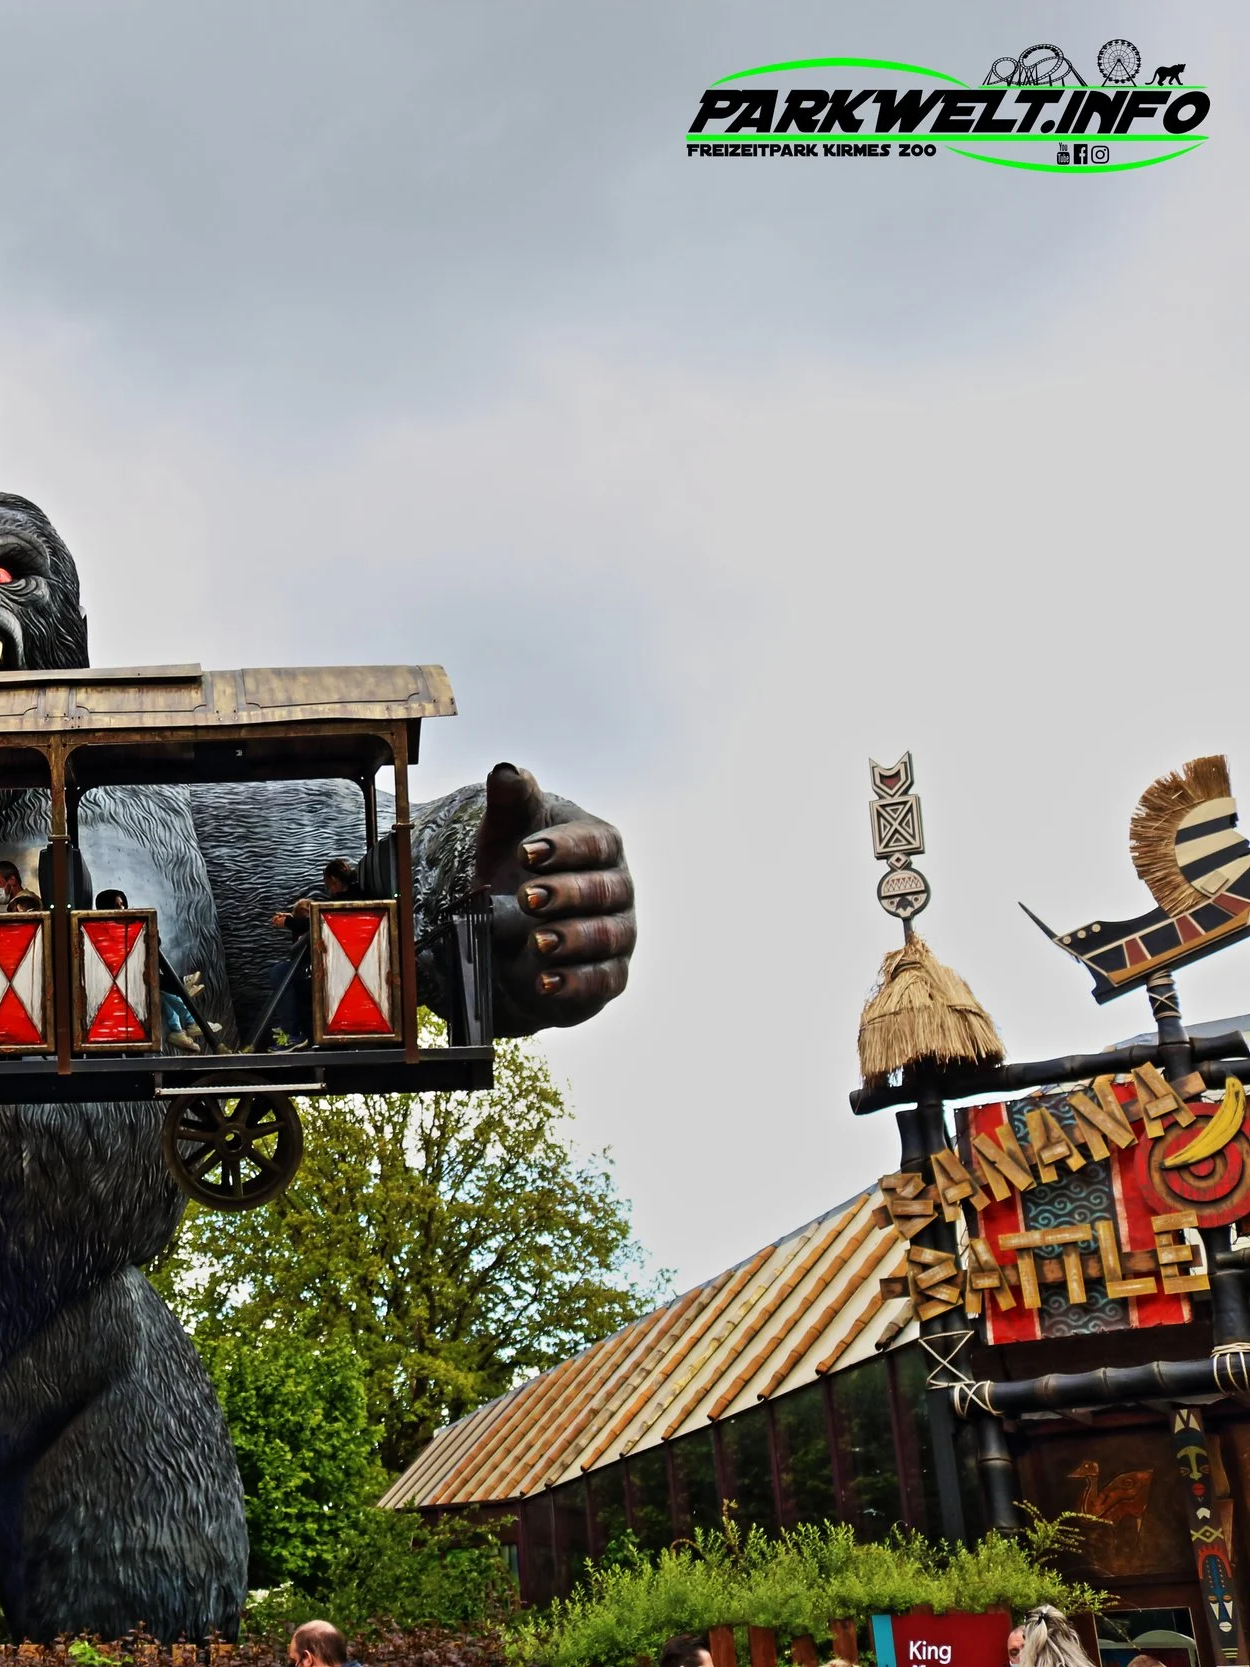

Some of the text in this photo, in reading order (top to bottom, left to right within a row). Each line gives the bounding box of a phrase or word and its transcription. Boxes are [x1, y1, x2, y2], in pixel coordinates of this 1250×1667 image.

[879, 1061, 1196, 1239] BANANA
[907, 1210, 1210, 1321] BATTLE
[909, 1640, 952, 1664] King
